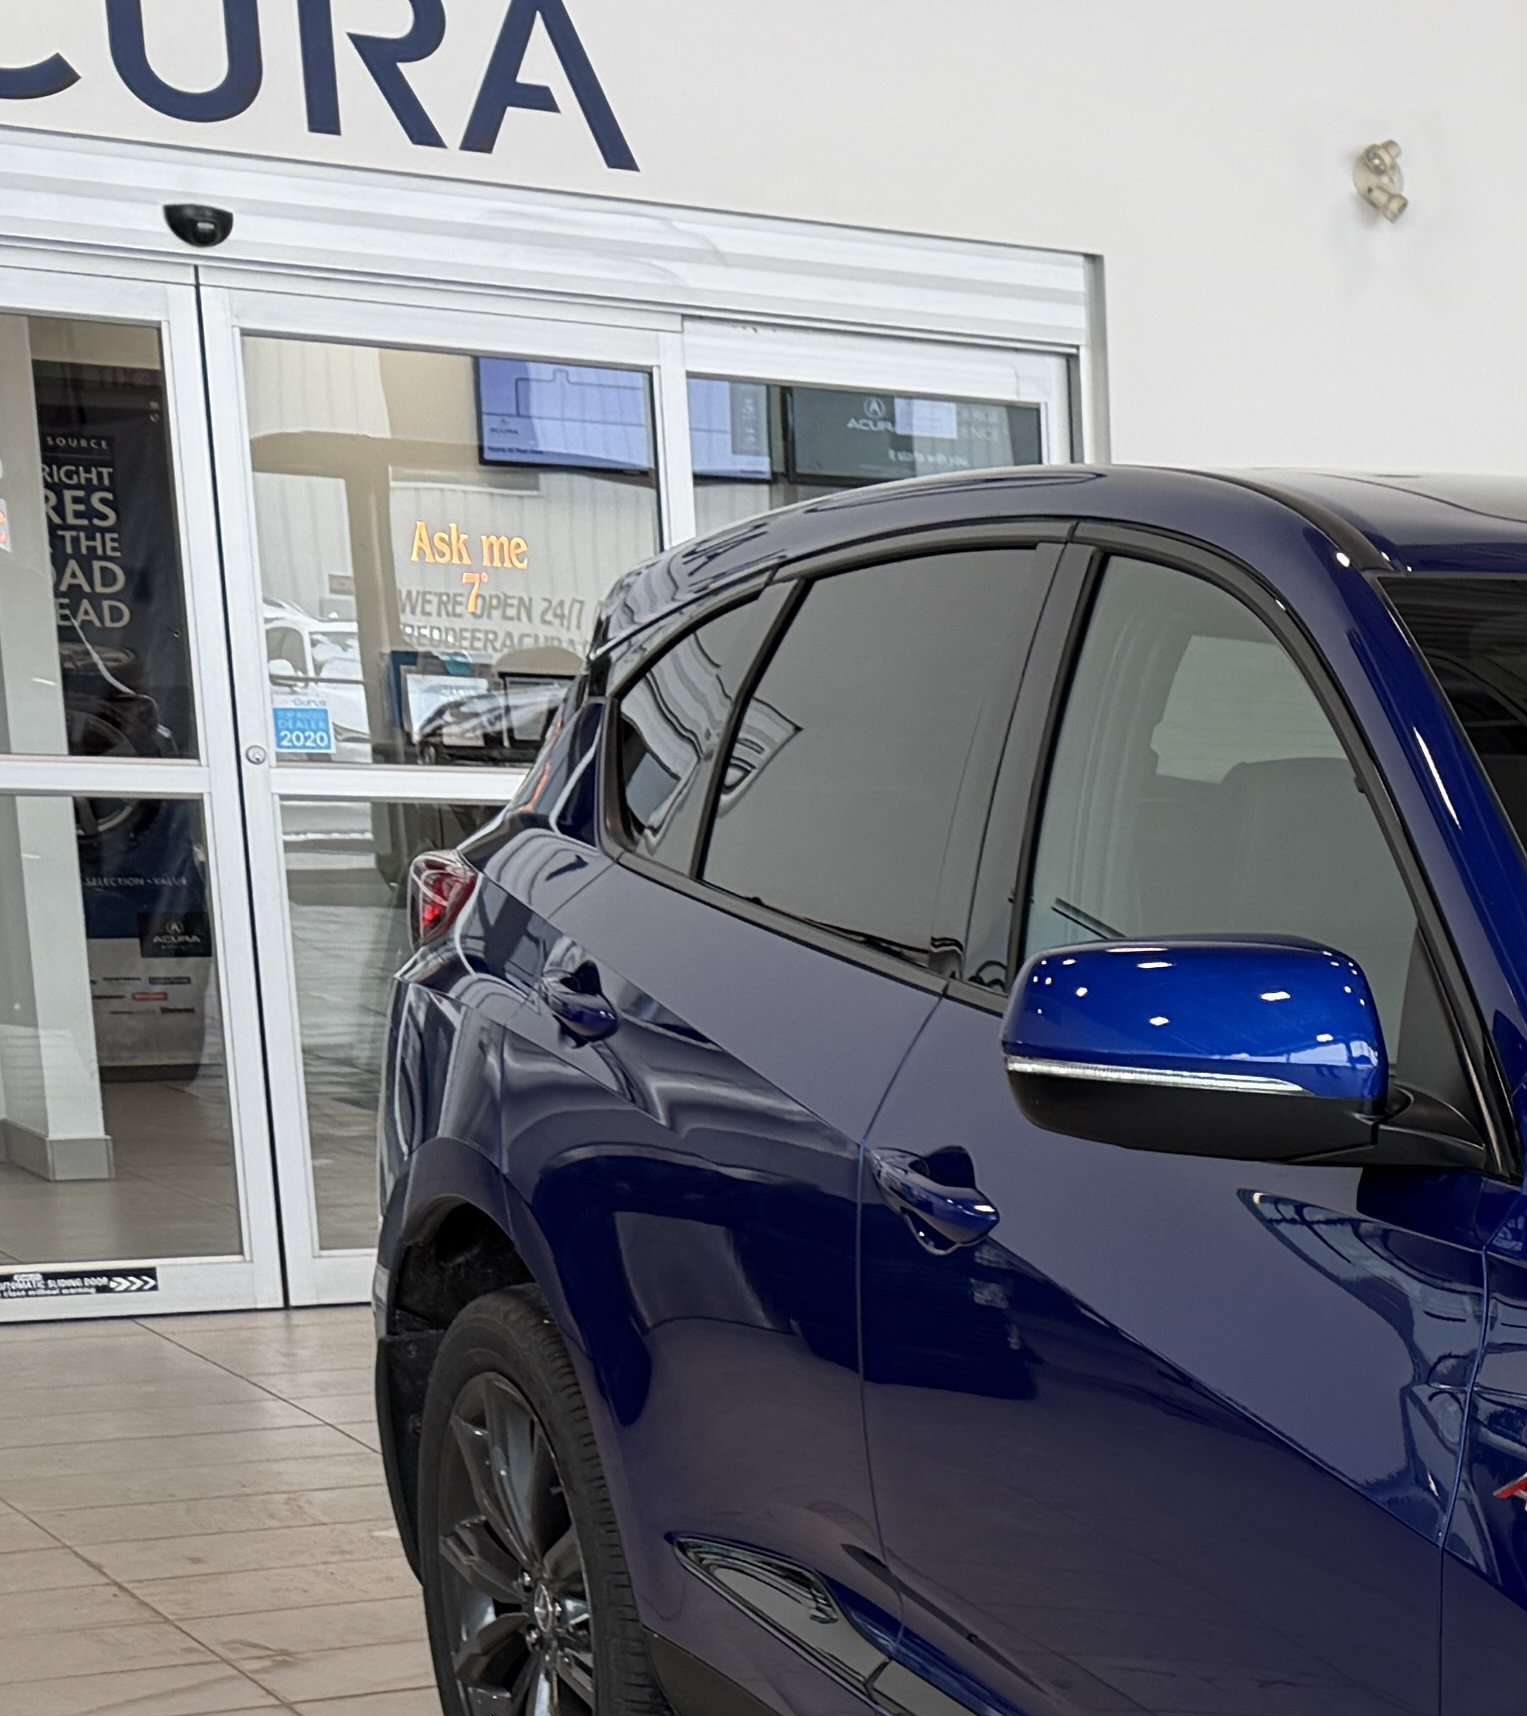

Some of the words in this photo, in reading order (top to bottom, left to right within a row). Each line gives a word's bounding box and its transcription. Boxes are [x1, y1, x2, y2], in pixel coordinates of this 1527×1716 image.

[0, 0, 641, 172] URA
[47, 436, 109, 450] SOURCE
[56, 530, 122, 557] THE
[410, 520, 471, 565] Ask
[481, 535, 530, 571] me
[51, 558, 127, 594] AD
[474, 592, 533, 624] OPEN
[540, 597, 585, 634] 24/7
[279, 730, 329, 747] 2020
